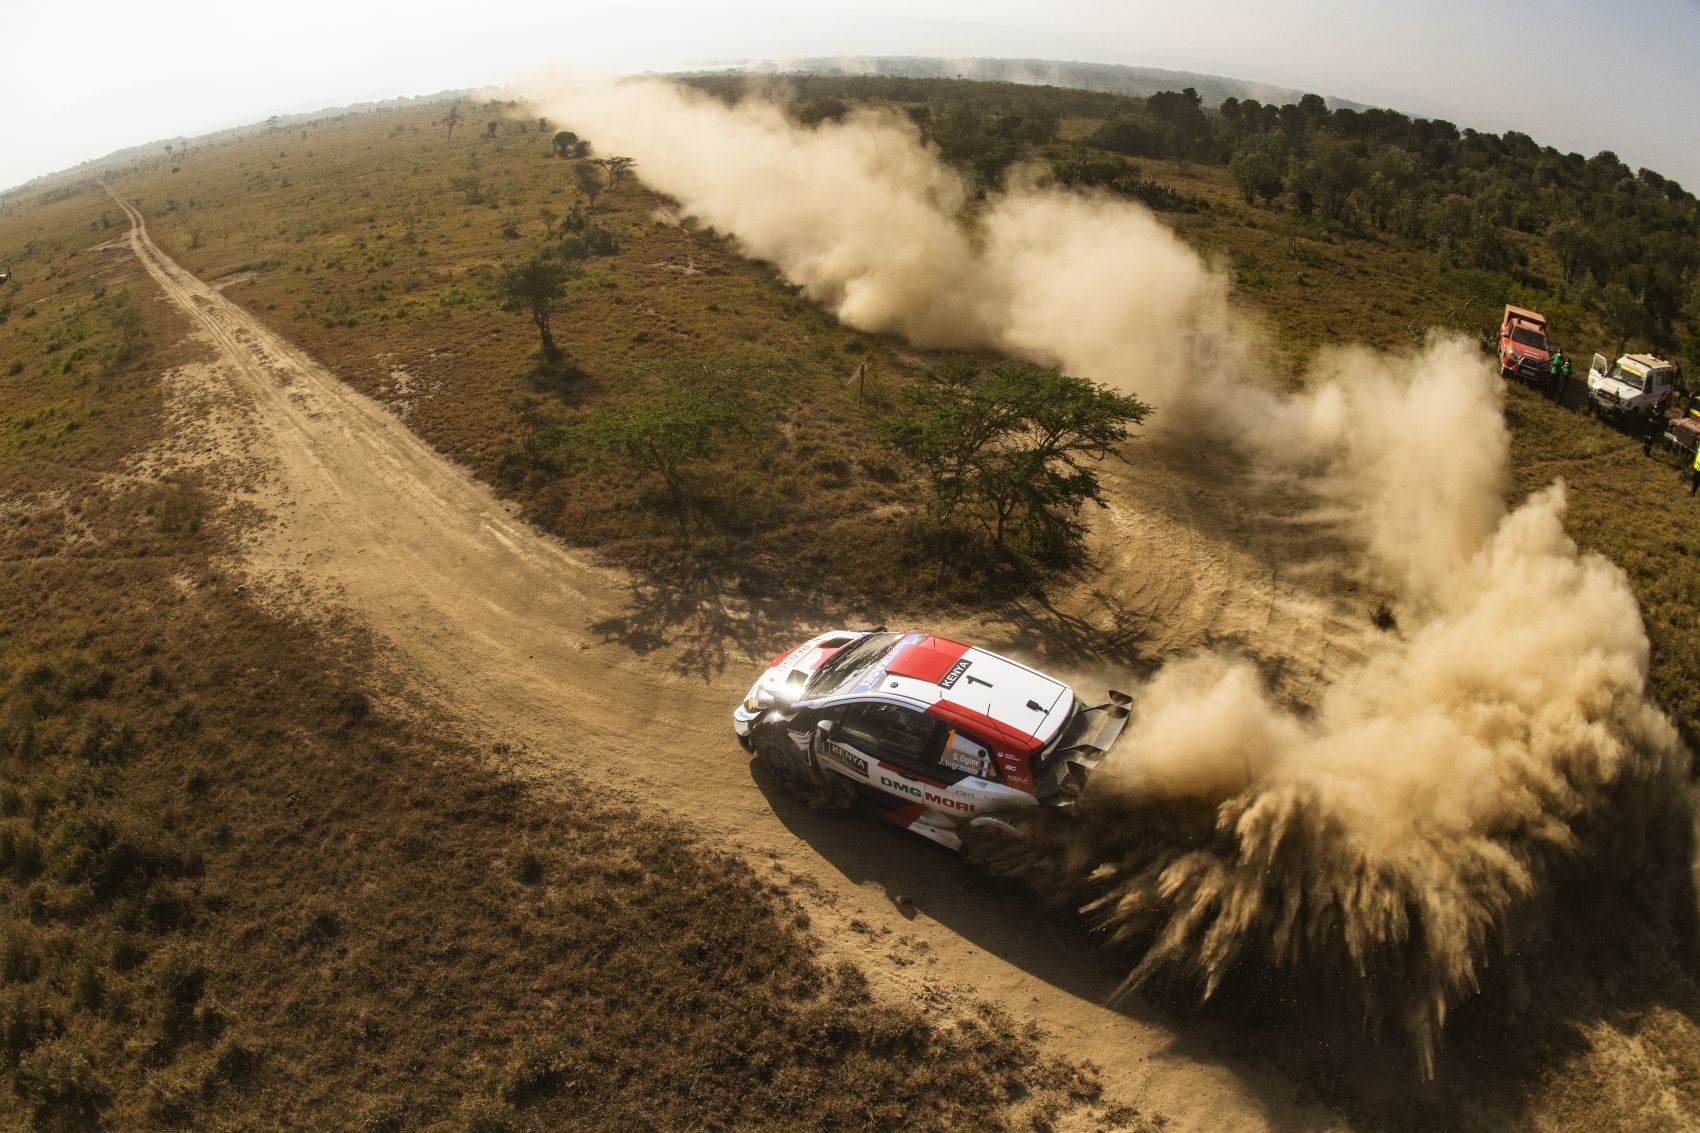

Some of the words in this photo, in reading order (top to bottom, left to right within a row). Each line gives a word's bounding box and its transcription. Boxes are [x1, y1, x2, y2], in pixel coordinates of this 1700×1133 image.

[941, 661, 970, 687] KENYA
[966, 675, 994, 689] 1
[948, 729, 955, 753] 1
[832, 744, 865, 769] KENYA
[953, 752, 979, 767] S.Ogier
[880, 776, 922, 798] DMG
[925, 791, 976, 812] MORI
